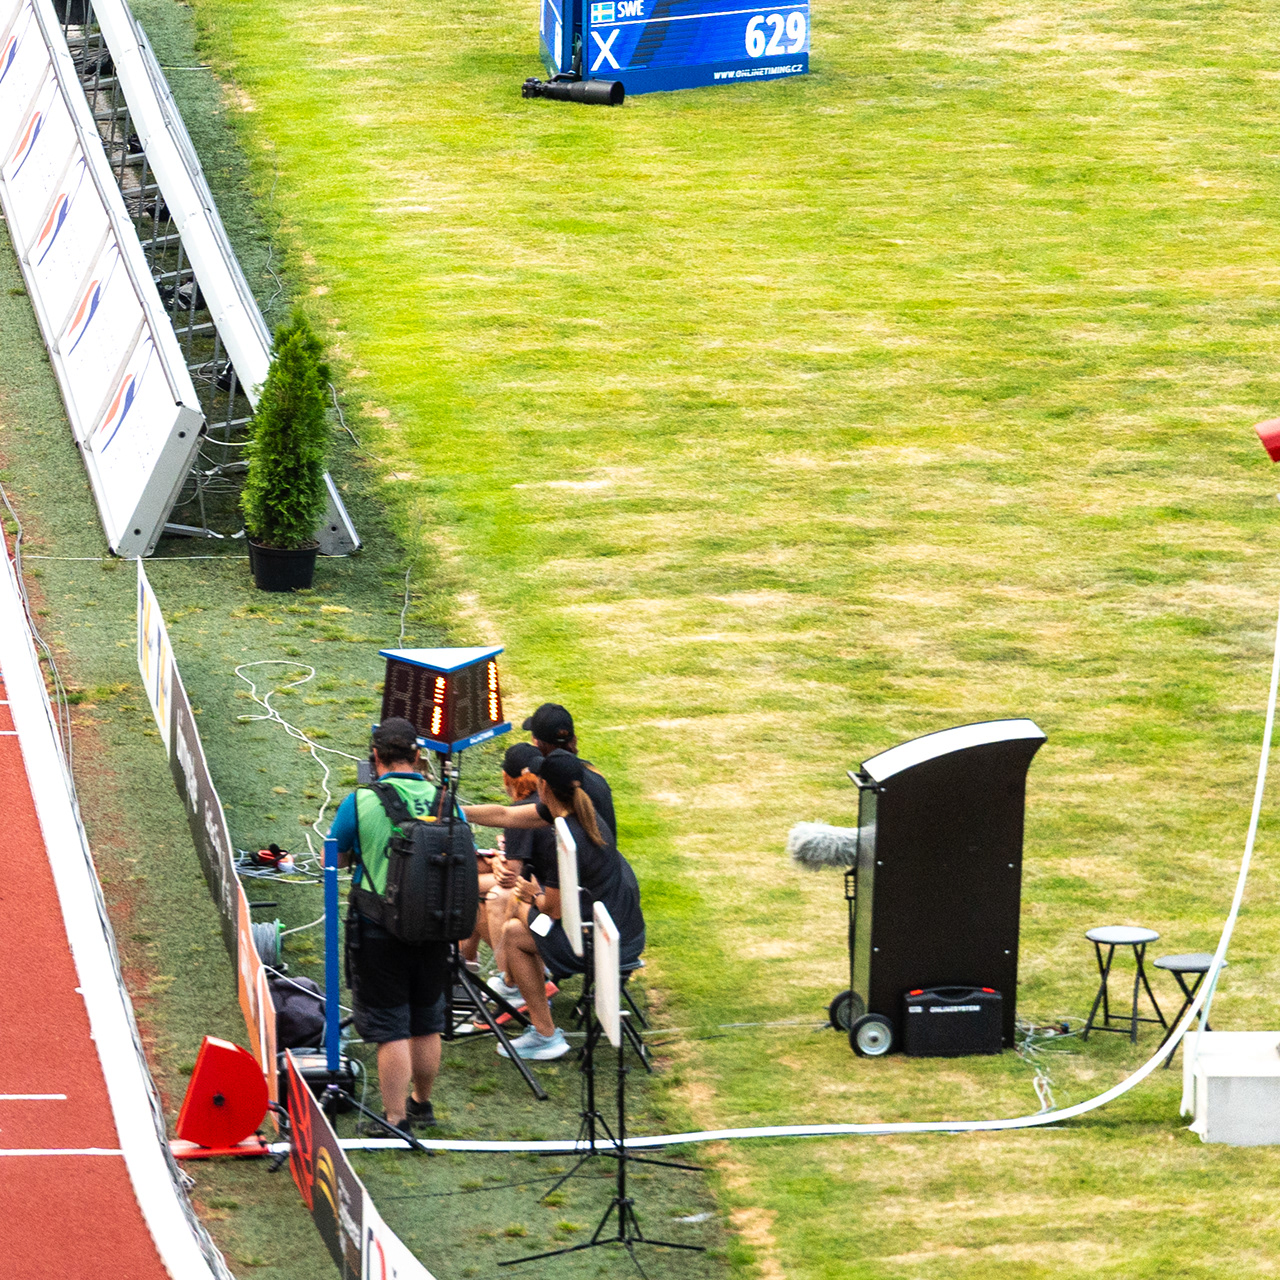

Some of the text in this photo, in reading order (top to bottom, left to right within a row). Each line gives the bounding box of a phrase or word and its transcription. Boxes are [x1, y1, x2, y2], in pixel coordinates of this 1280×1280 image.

[617, 0, 644, 18] SWE
[591, 28, 620, 72] X
[745, 11, 807, 59] 629
